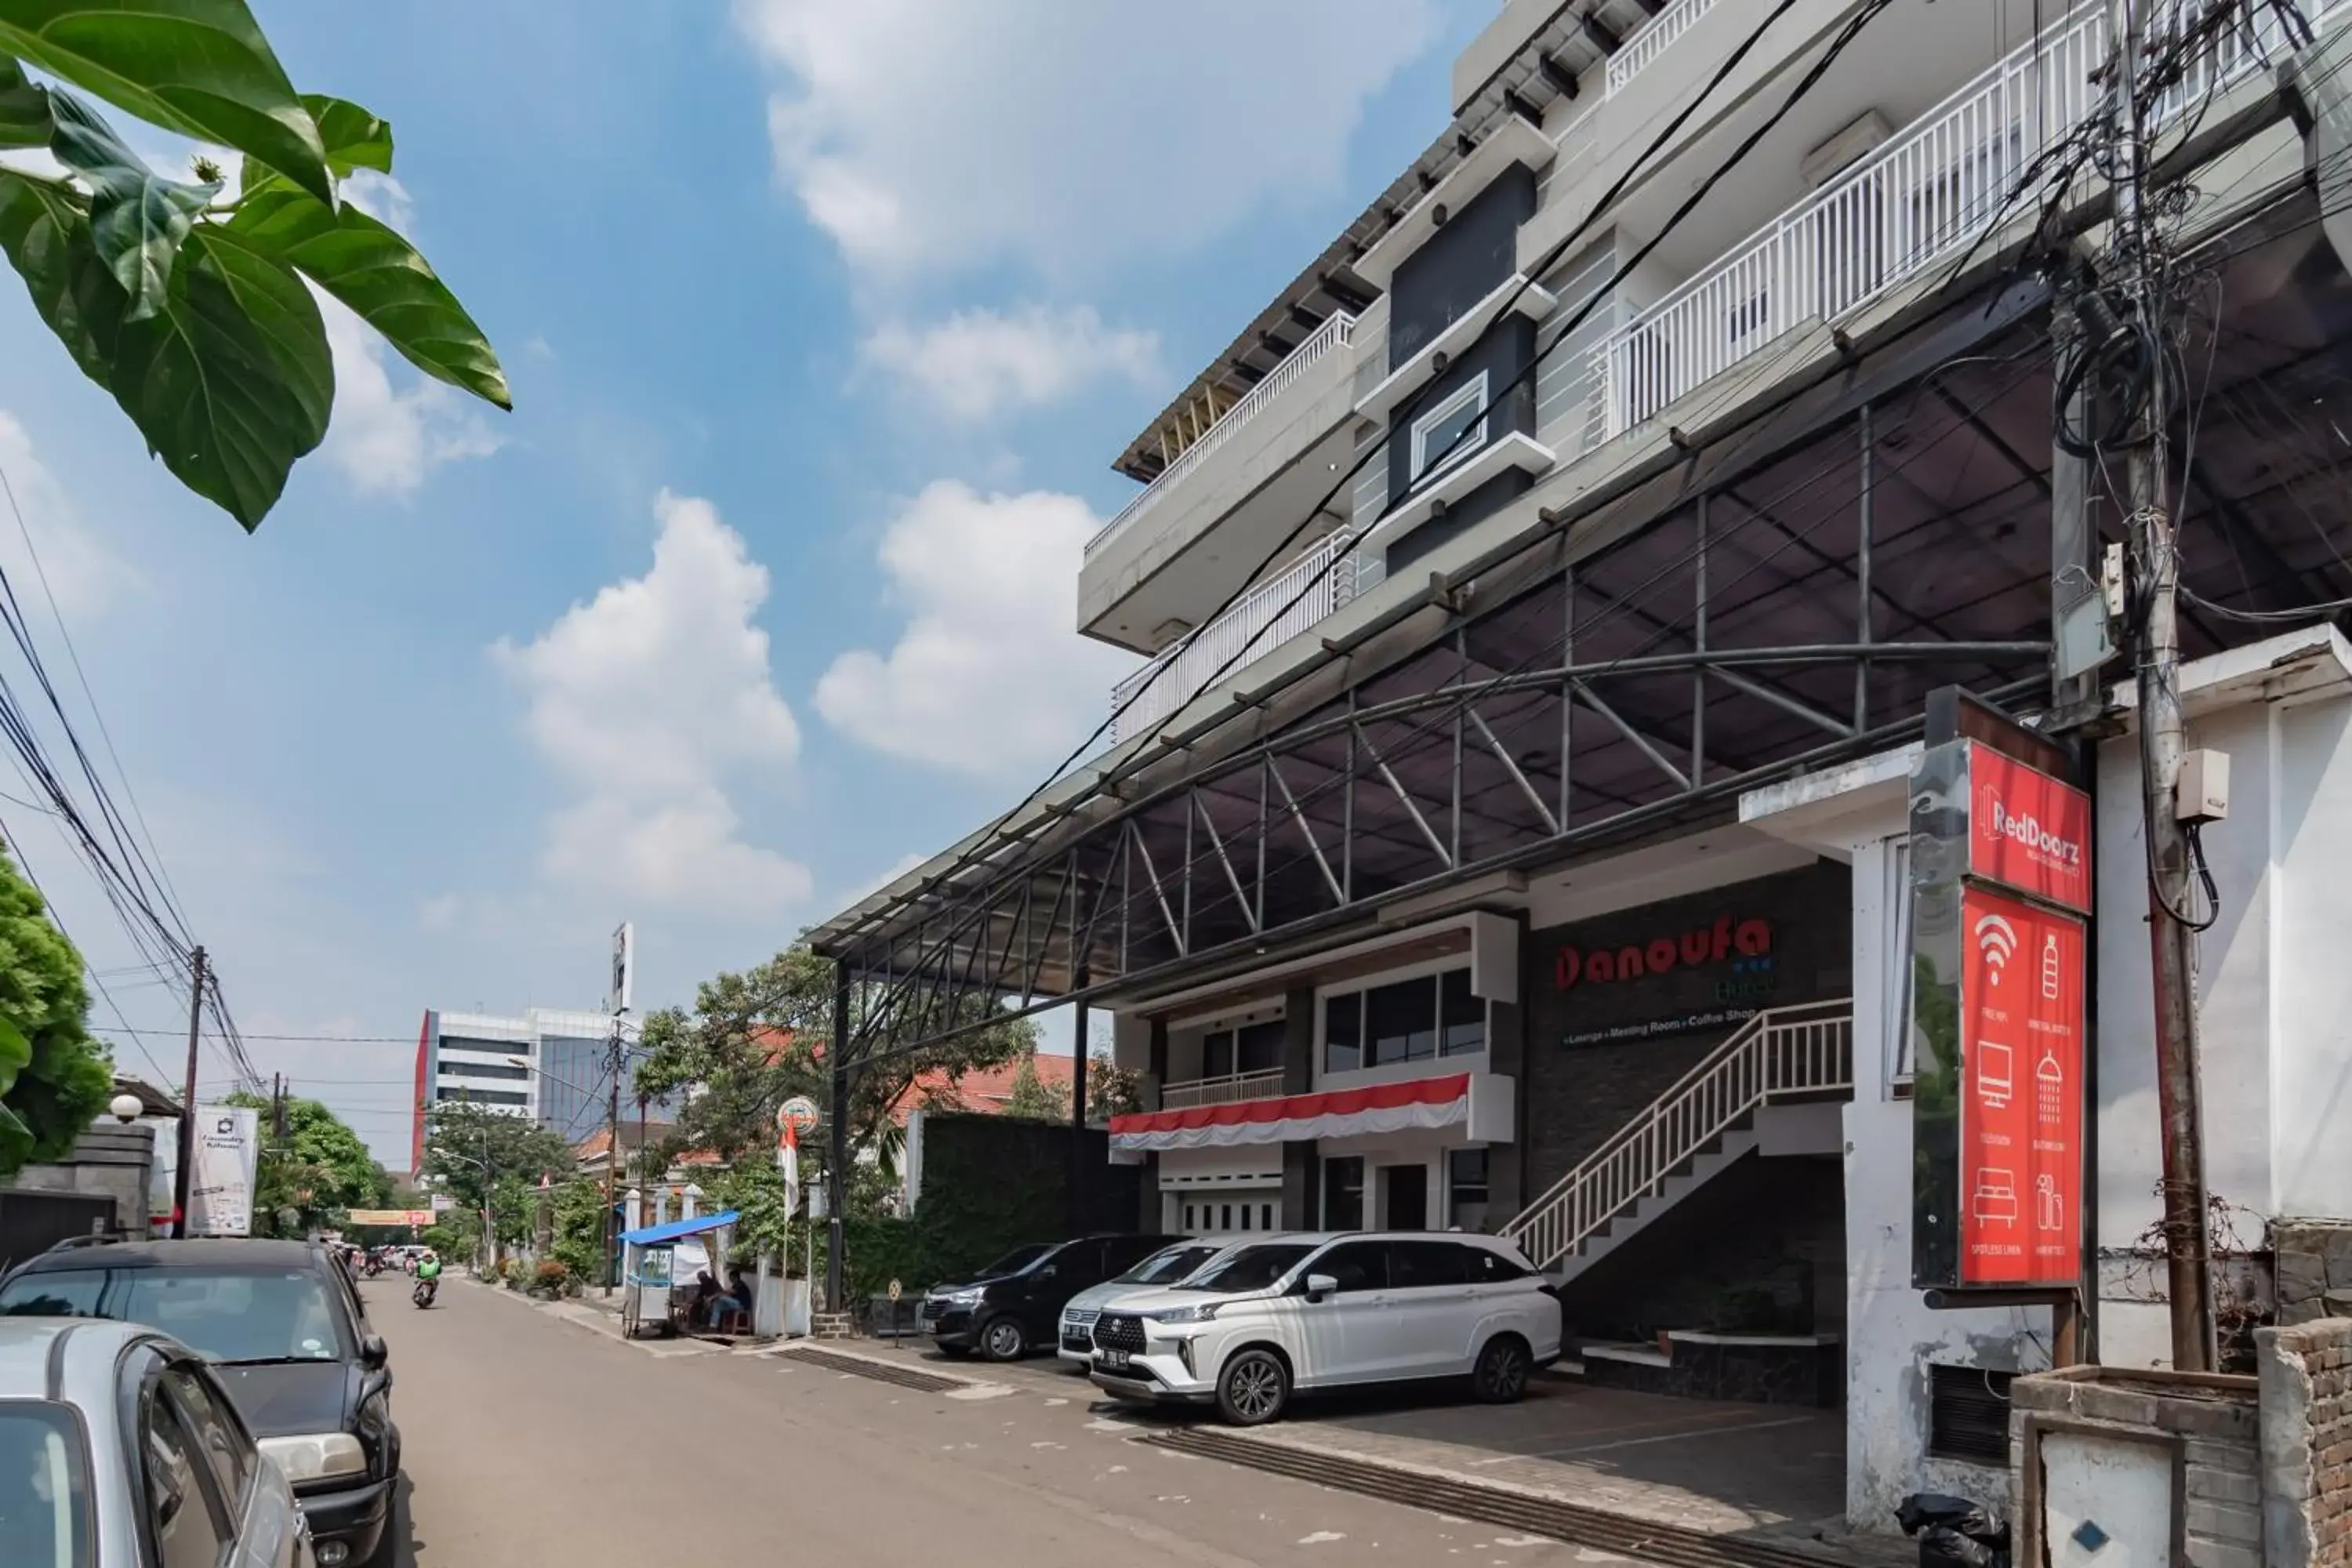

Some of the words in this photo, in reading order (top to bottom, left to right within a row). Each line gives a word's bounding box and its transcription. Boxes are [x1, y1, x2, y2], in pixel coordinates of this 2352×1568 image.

[1994, 801, 2080, 864] RedDoorz
[1556, 910, 1771, 991] Danoufa
[1569, 1033, 1602, 1044] Lounge
[1610, 1025, 1649, 1038] Meeting
[1650, 1019, 1681, 1032] Room
[1688, 1014, 1723, 1025] Coffee
[1726, 1008, 1756, 1022] Shop
